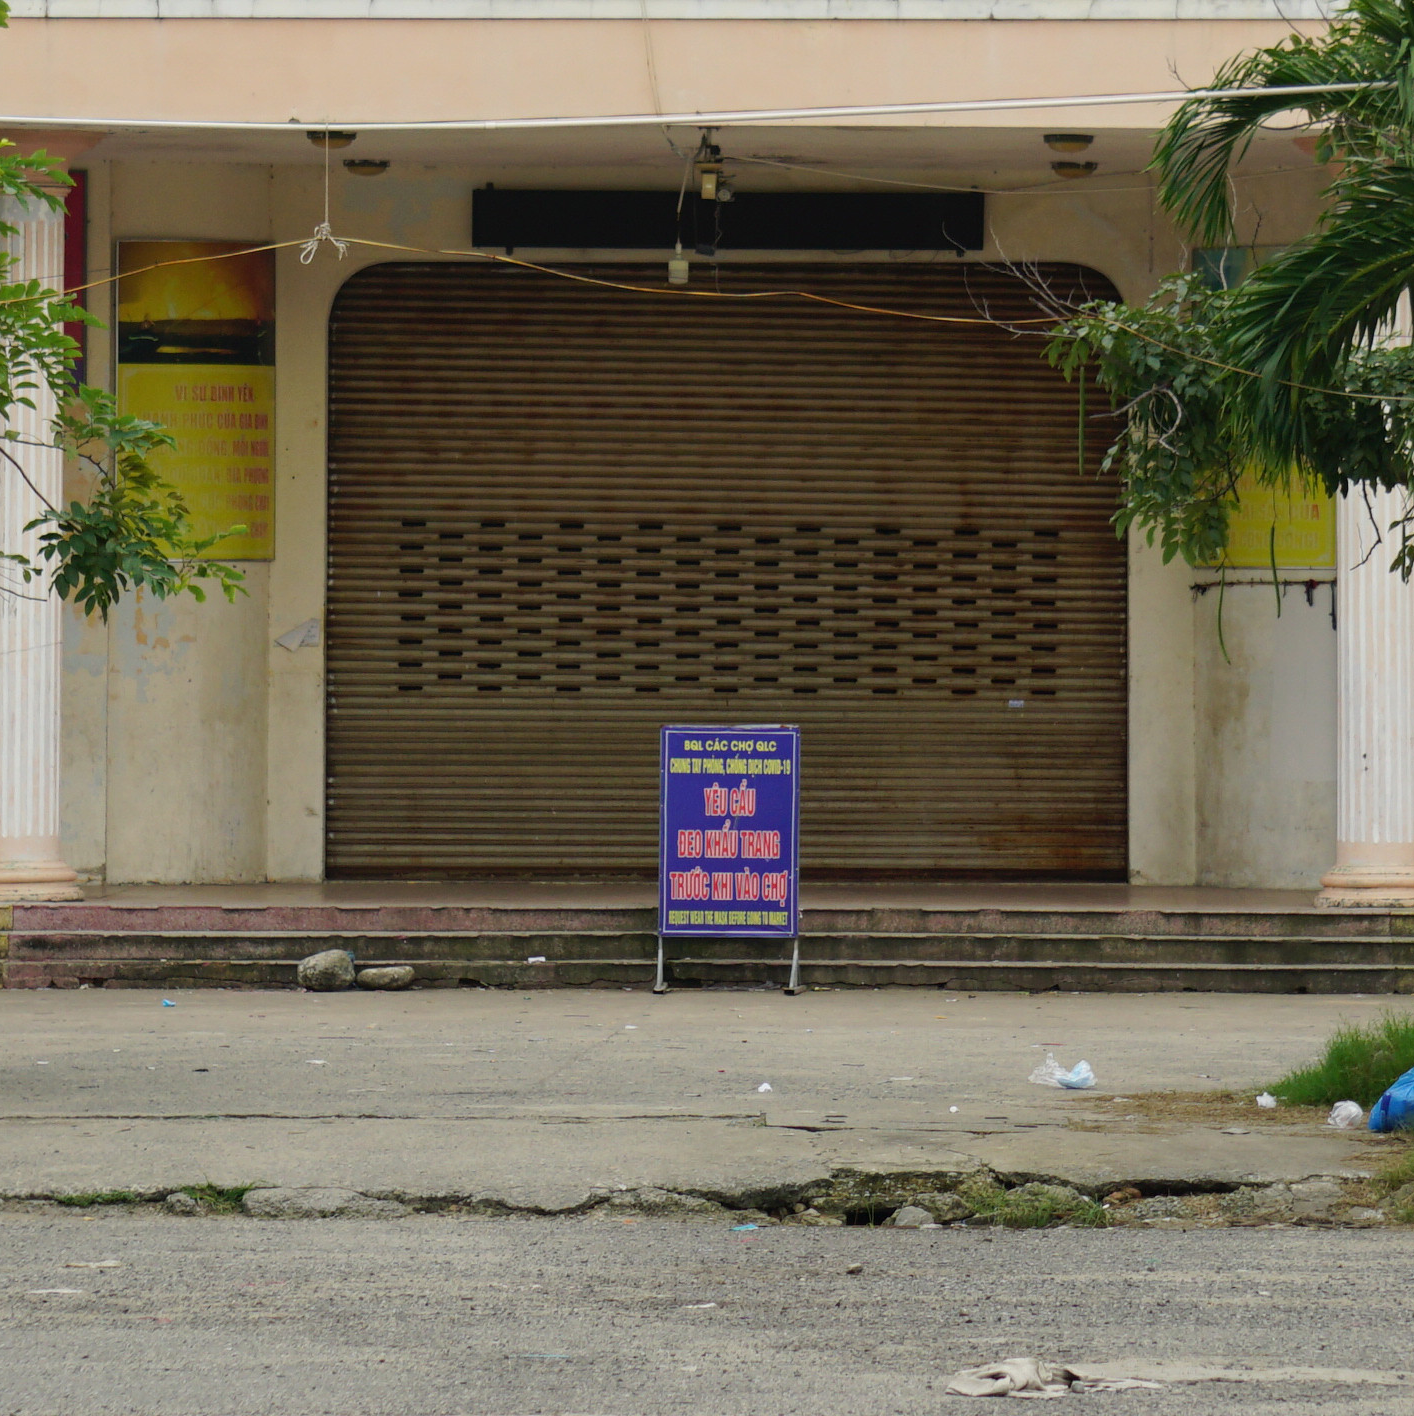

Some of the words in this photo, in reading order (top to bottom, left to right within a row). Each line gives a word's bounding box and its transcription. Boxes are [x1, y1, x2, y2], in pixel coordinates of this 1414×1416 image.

[684, 740, 705, 752] BQL
[705, 737, 728, 752] CÁC
[730, 740, 755, 754] CHỢ
[756, 741, 777, 752] QLC
[704, 783, 728, 816] YÊU
[678, 830, 703, 858] ĐEO
[704, 820, 738, 858] KHẨU
[740, 831, 780, 859] TRANG
[670, 867, 710, 900] TRƯỚC
[712, 872, 733, 900] KHI
[736, 867, 759, 900] VÀO
[762, 871, 789, 907] CHỢ
